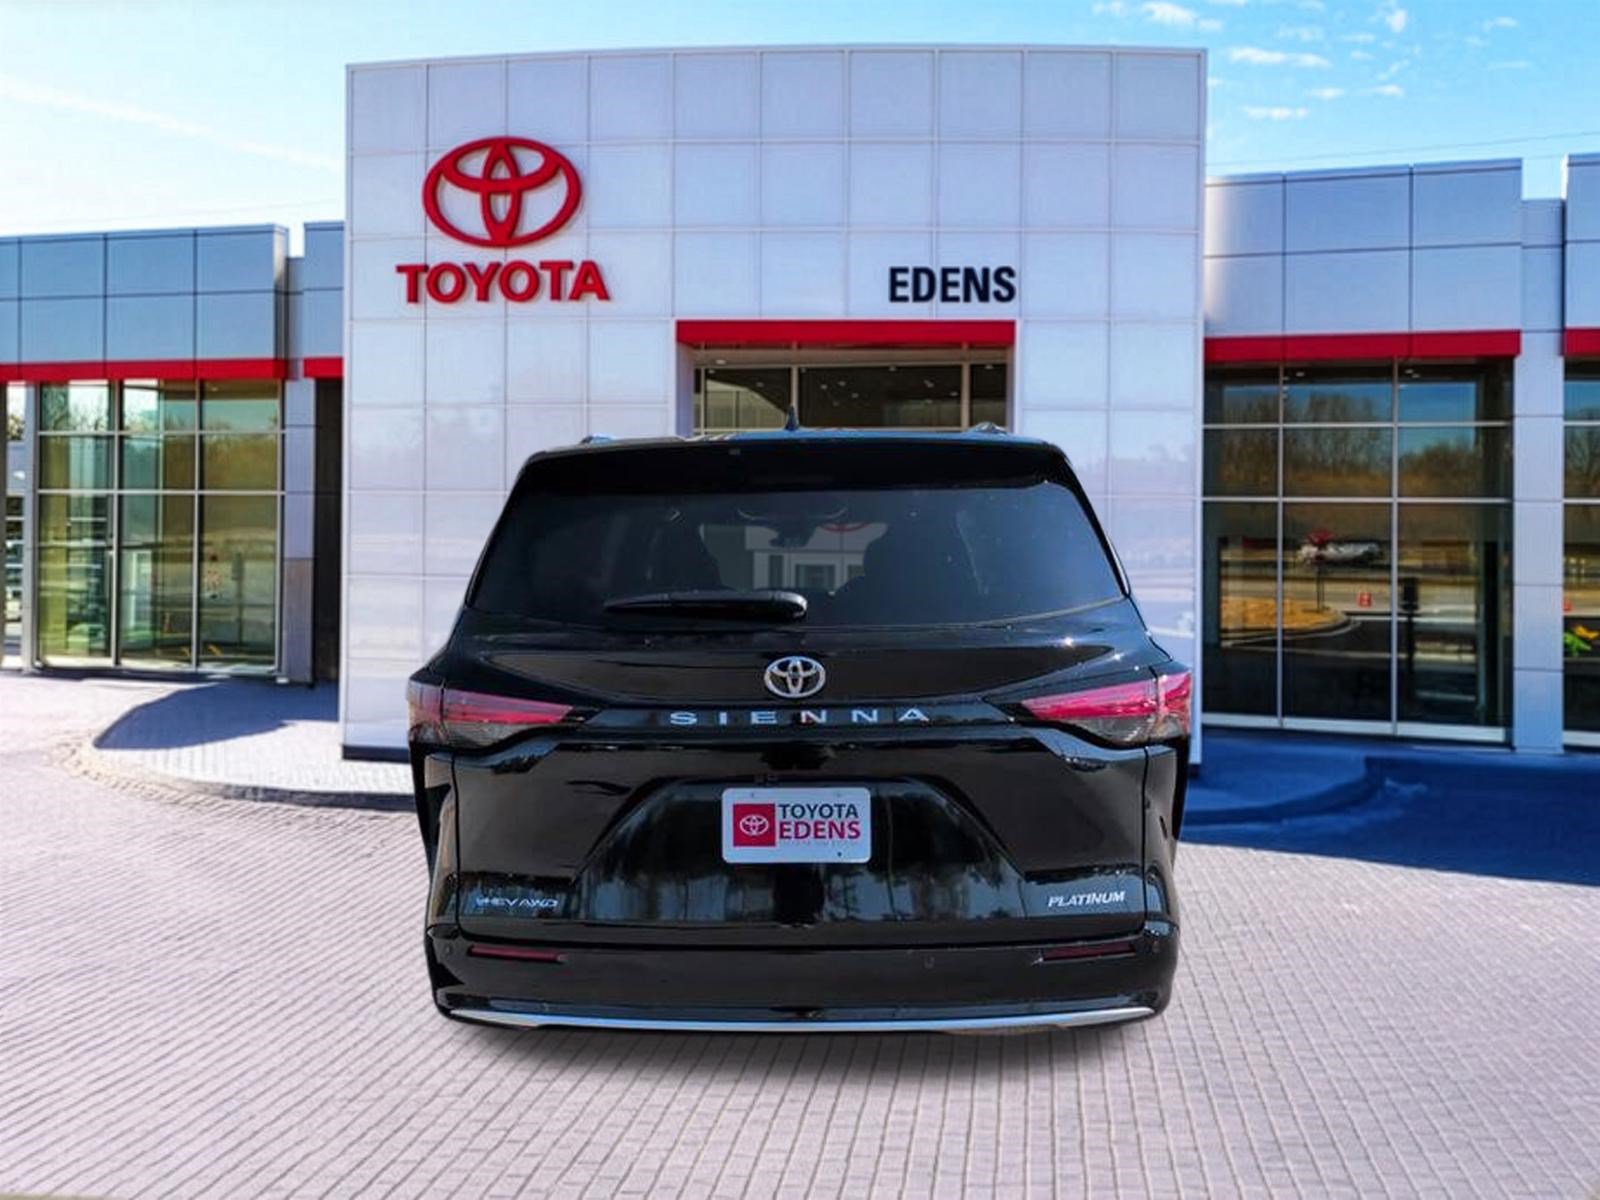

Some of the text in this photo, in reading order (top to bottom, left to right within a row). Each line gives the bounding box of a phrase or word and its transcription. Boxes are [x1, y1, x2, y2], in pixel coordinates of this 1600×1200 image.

[397, 260, 610, 304] TOYOTA
[888, 266, 1017, 303] EDENS
[669, 708, 929, 725] SIENNA
[778, 803, 859, 819] TOYOTA
[779, 821, 861, 839] EDENS
[1047, 890, 1126, 907] PLATINUM
